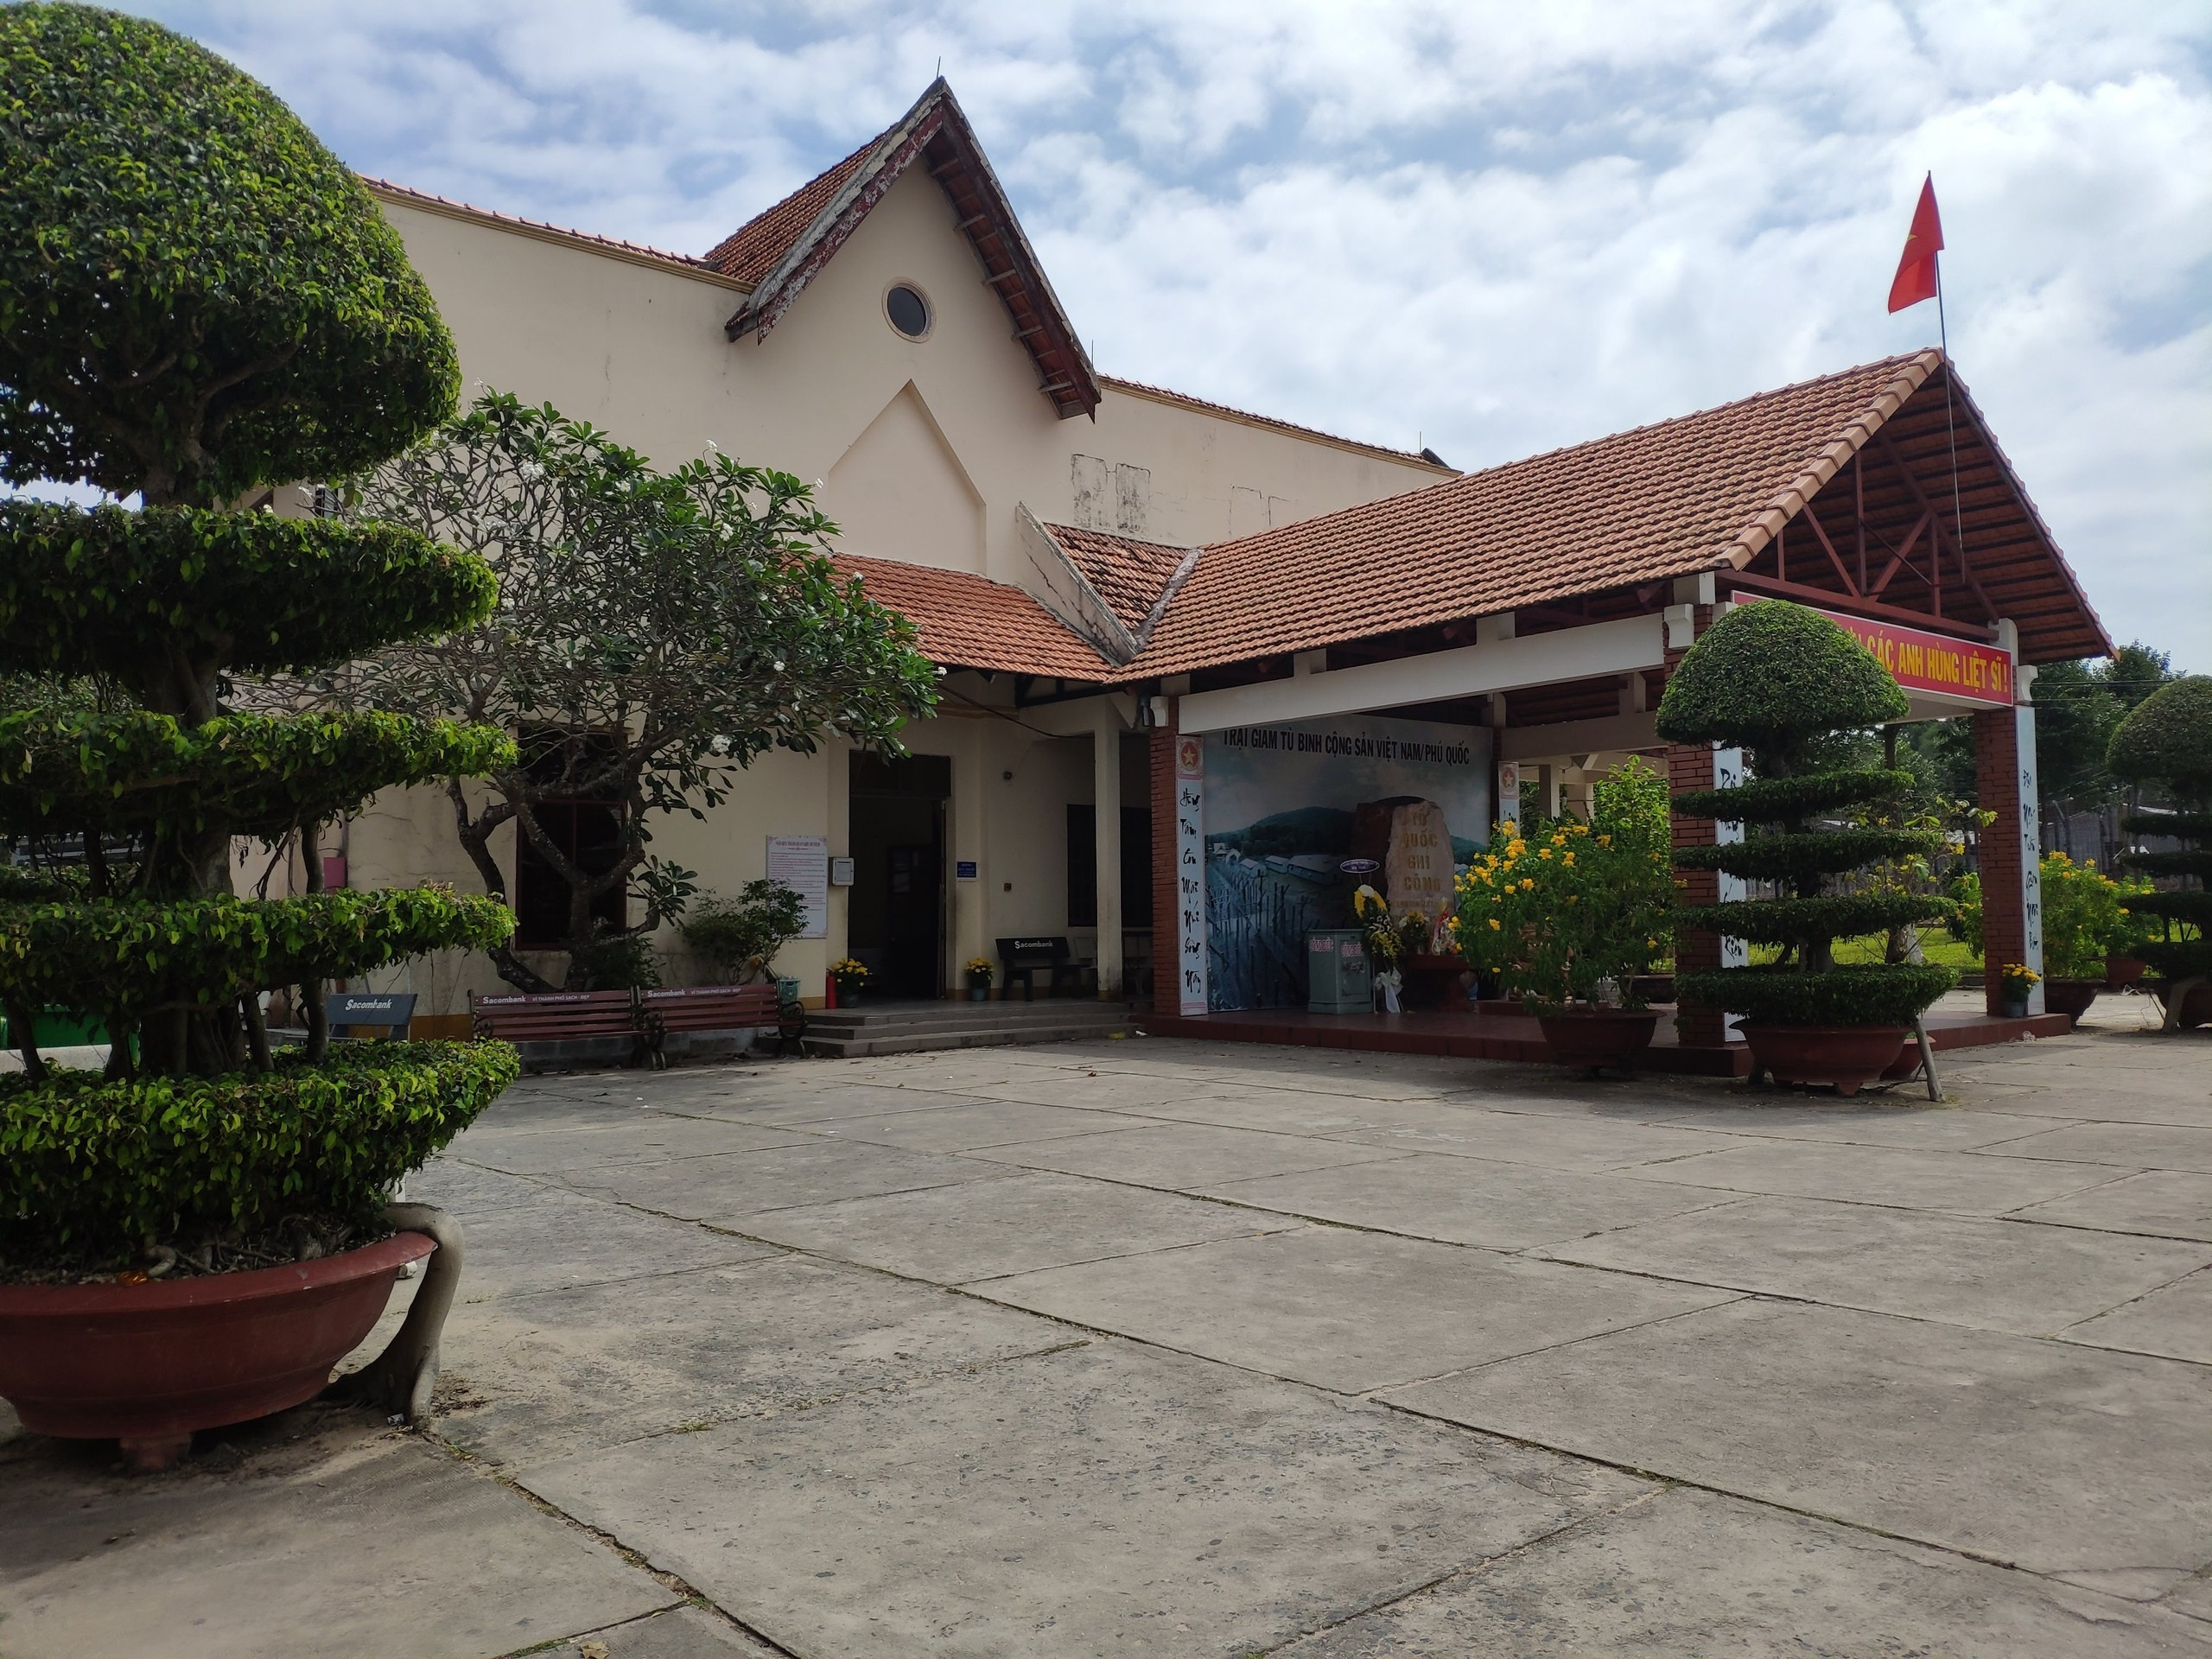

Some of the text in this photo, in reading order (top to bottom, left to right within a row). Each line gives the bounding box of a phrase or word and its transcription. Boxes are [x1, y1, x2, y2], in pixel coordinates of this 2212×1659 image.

[1897, 642, 1924, 677] ANH
[1927, 641, 1960, 683] HÙNG
[1962, 651, 1987, 693] LIỆT
[1251, 728, 1277, 749] GIAM
[1281, 727, 1294, 751] TÙ
[1298, 733, 1322, 753] BINH
[1325, 730, 1351, 759] CỘNG
[1354, 731, 1374, 758] SẢN
[1376, 735, 1397, 762] VIỆT
[1446, 741, 1470, 766] QUỐC
[1401, 828, 1439, 849] QUỐC
[1408, 855, 1430, 870] GHI
[1404, 874, 1440, 892] CÔNG
[1014, 940, 1054, 950] Sacombank
[482, 995, 526, 1004] Sacombank
[647, 988, 686, 997] Sacombank
[345, 998, 393, 1012] Sacombank
